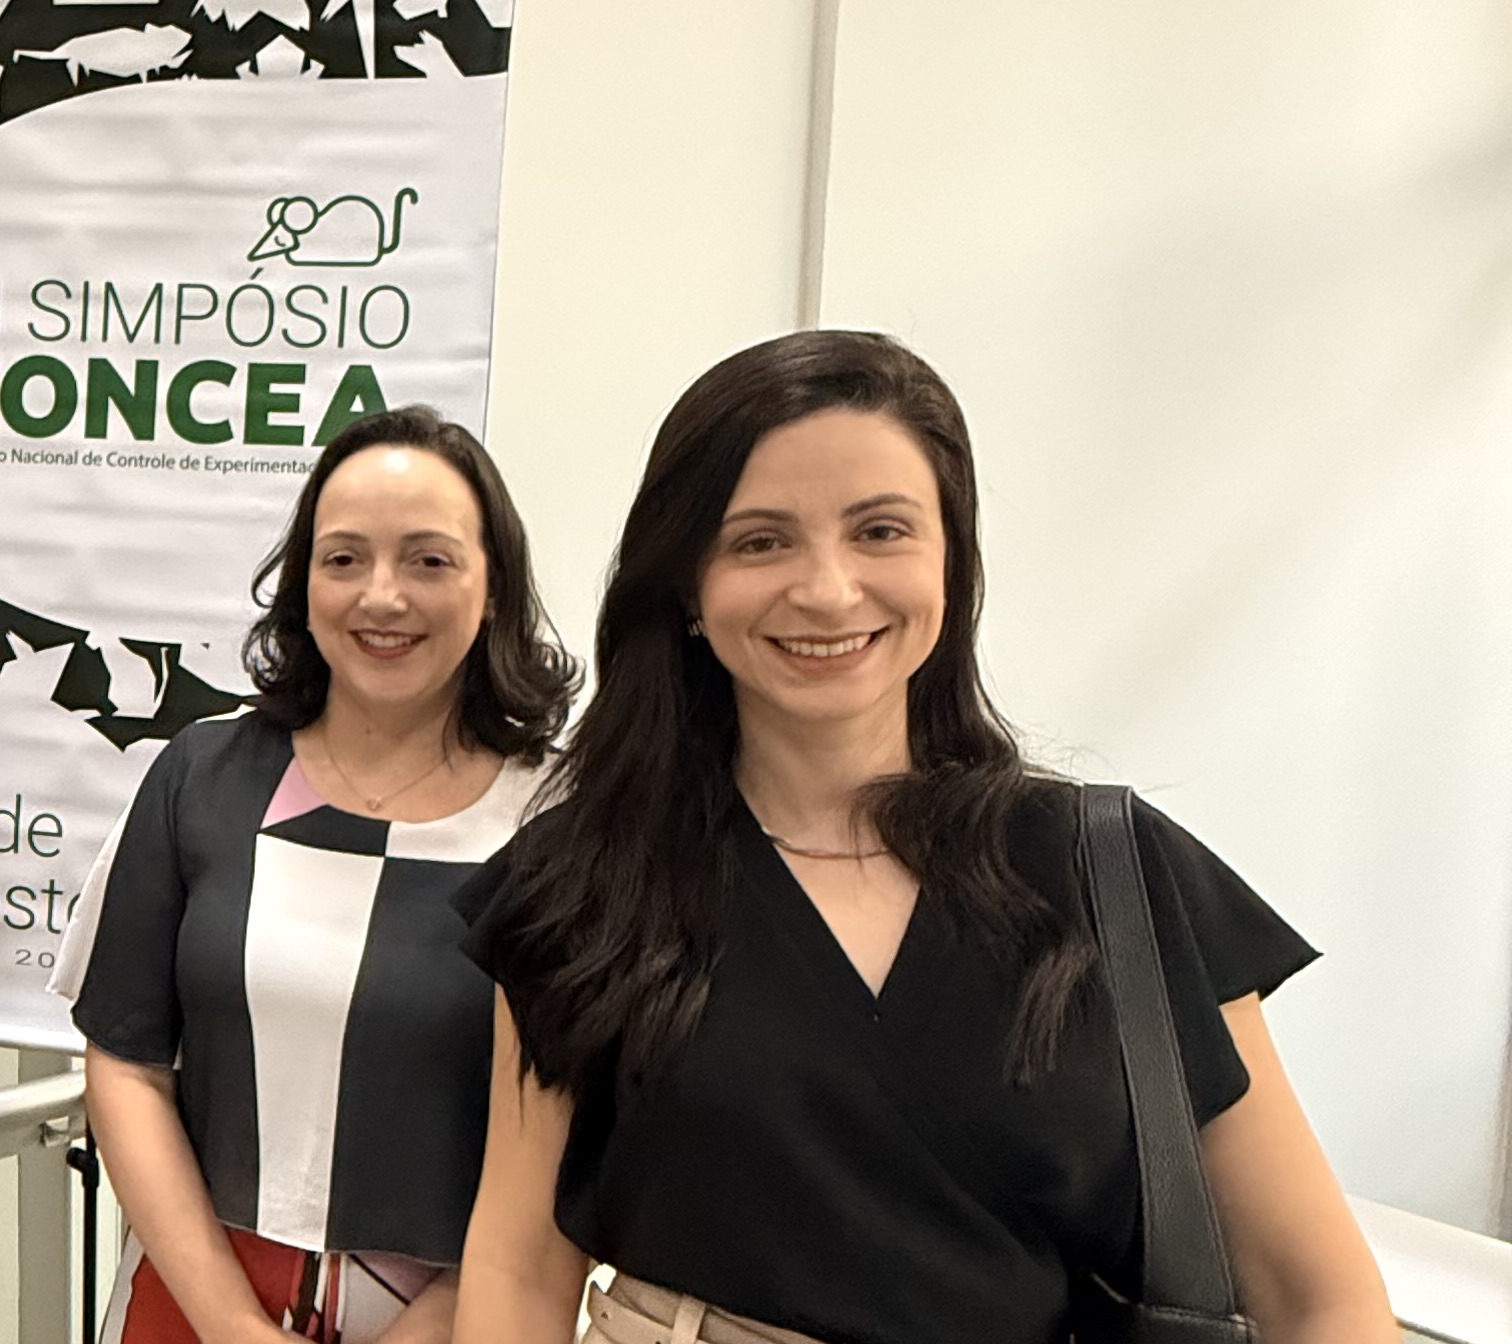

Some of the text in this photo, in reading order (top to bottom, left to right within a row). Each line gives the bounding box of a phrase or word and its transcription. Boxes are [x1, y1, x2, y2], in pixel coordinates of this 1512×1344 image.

[27, 268, 411, 350] SIMPÓSIO
[11, 448, 78, 466] Nacional
[82, 450, 102, 467] de
[106, 452, 175, 470] Controle
[179, 455, 200, 471] de
